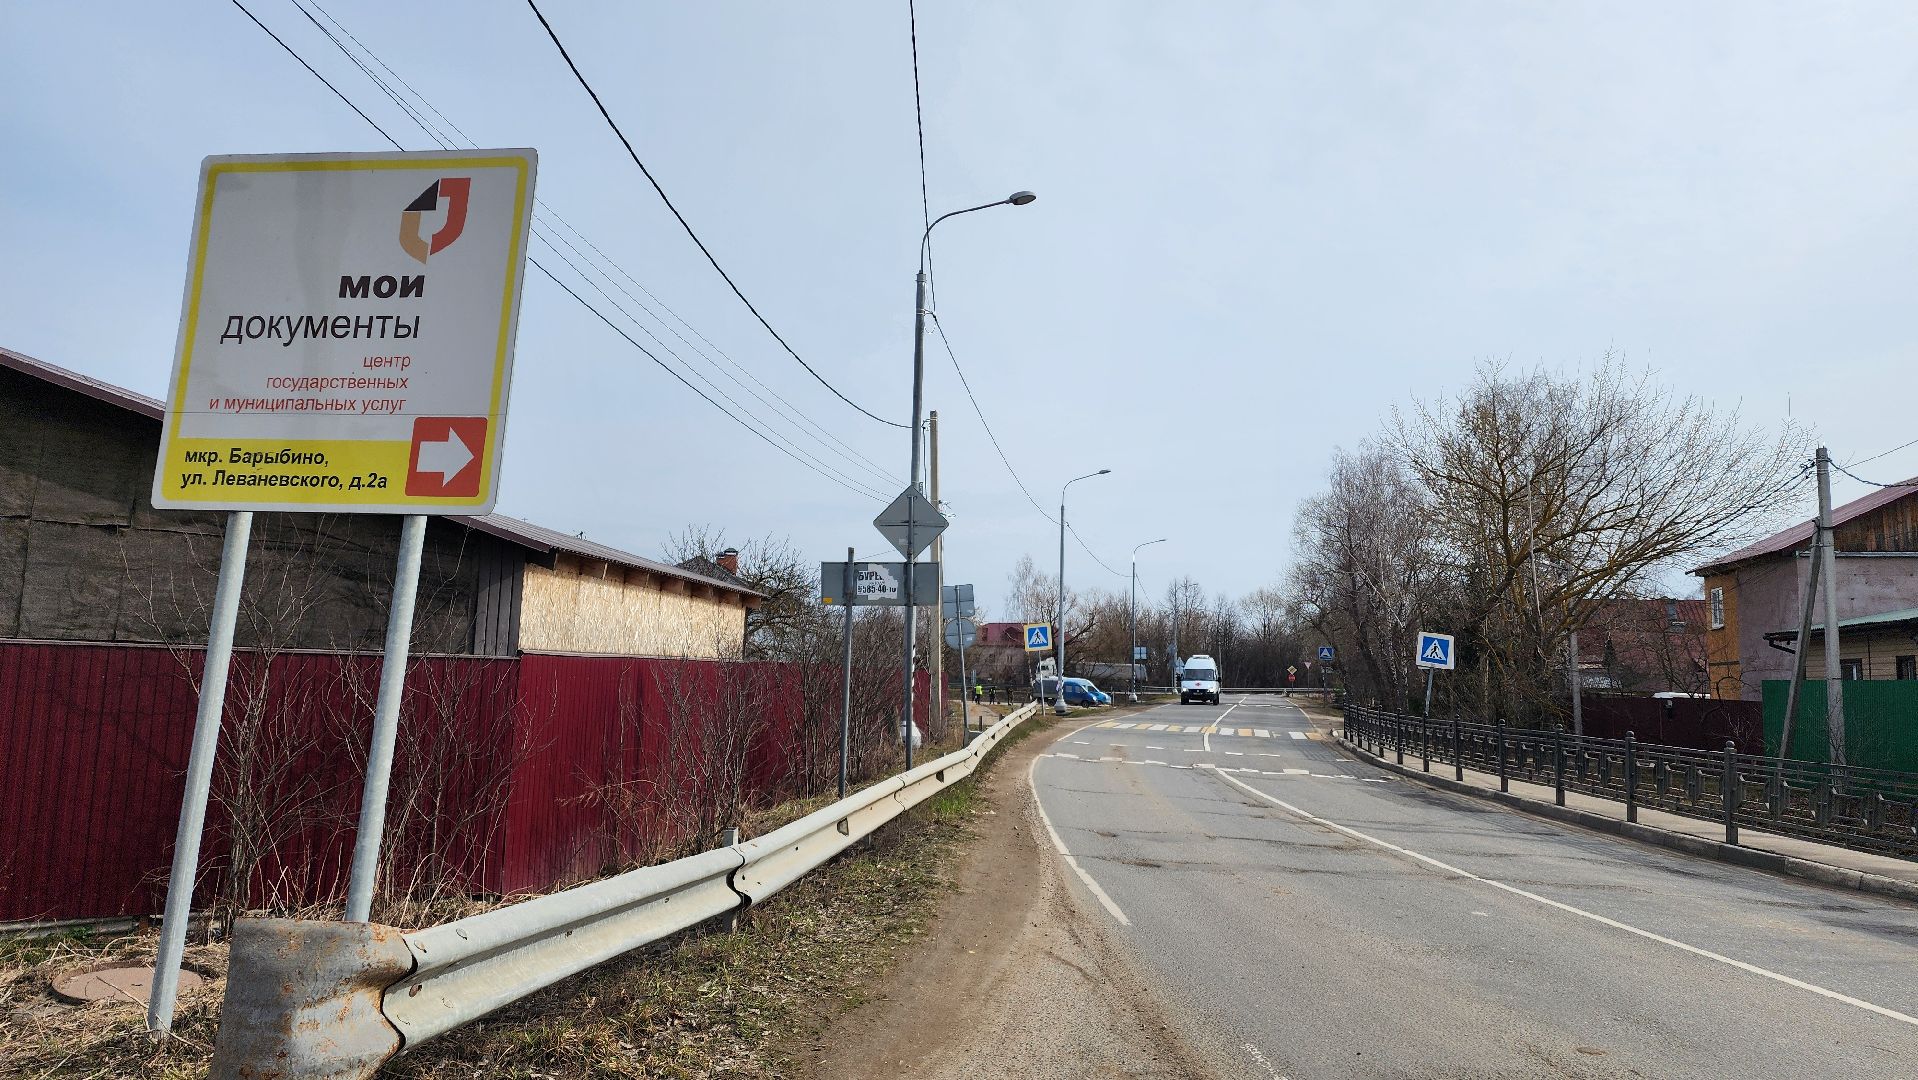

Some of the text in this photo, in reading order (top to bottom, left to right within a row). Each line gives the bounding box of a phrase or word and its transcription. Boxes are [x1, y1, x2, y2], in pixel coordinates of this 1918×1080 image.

[338, 274, 425, 298] мои
[220, 315, 420, 347] документы
[363, 355, 411, 371] центр
[266, 375, 409, 391] государственных
[209, 398, 407, 415] и муниципальных услуг
[184, 447, 329, 467] мкр. Барыбино,
[180, 470, 388, 490] ул. Леваневского, д.2а
